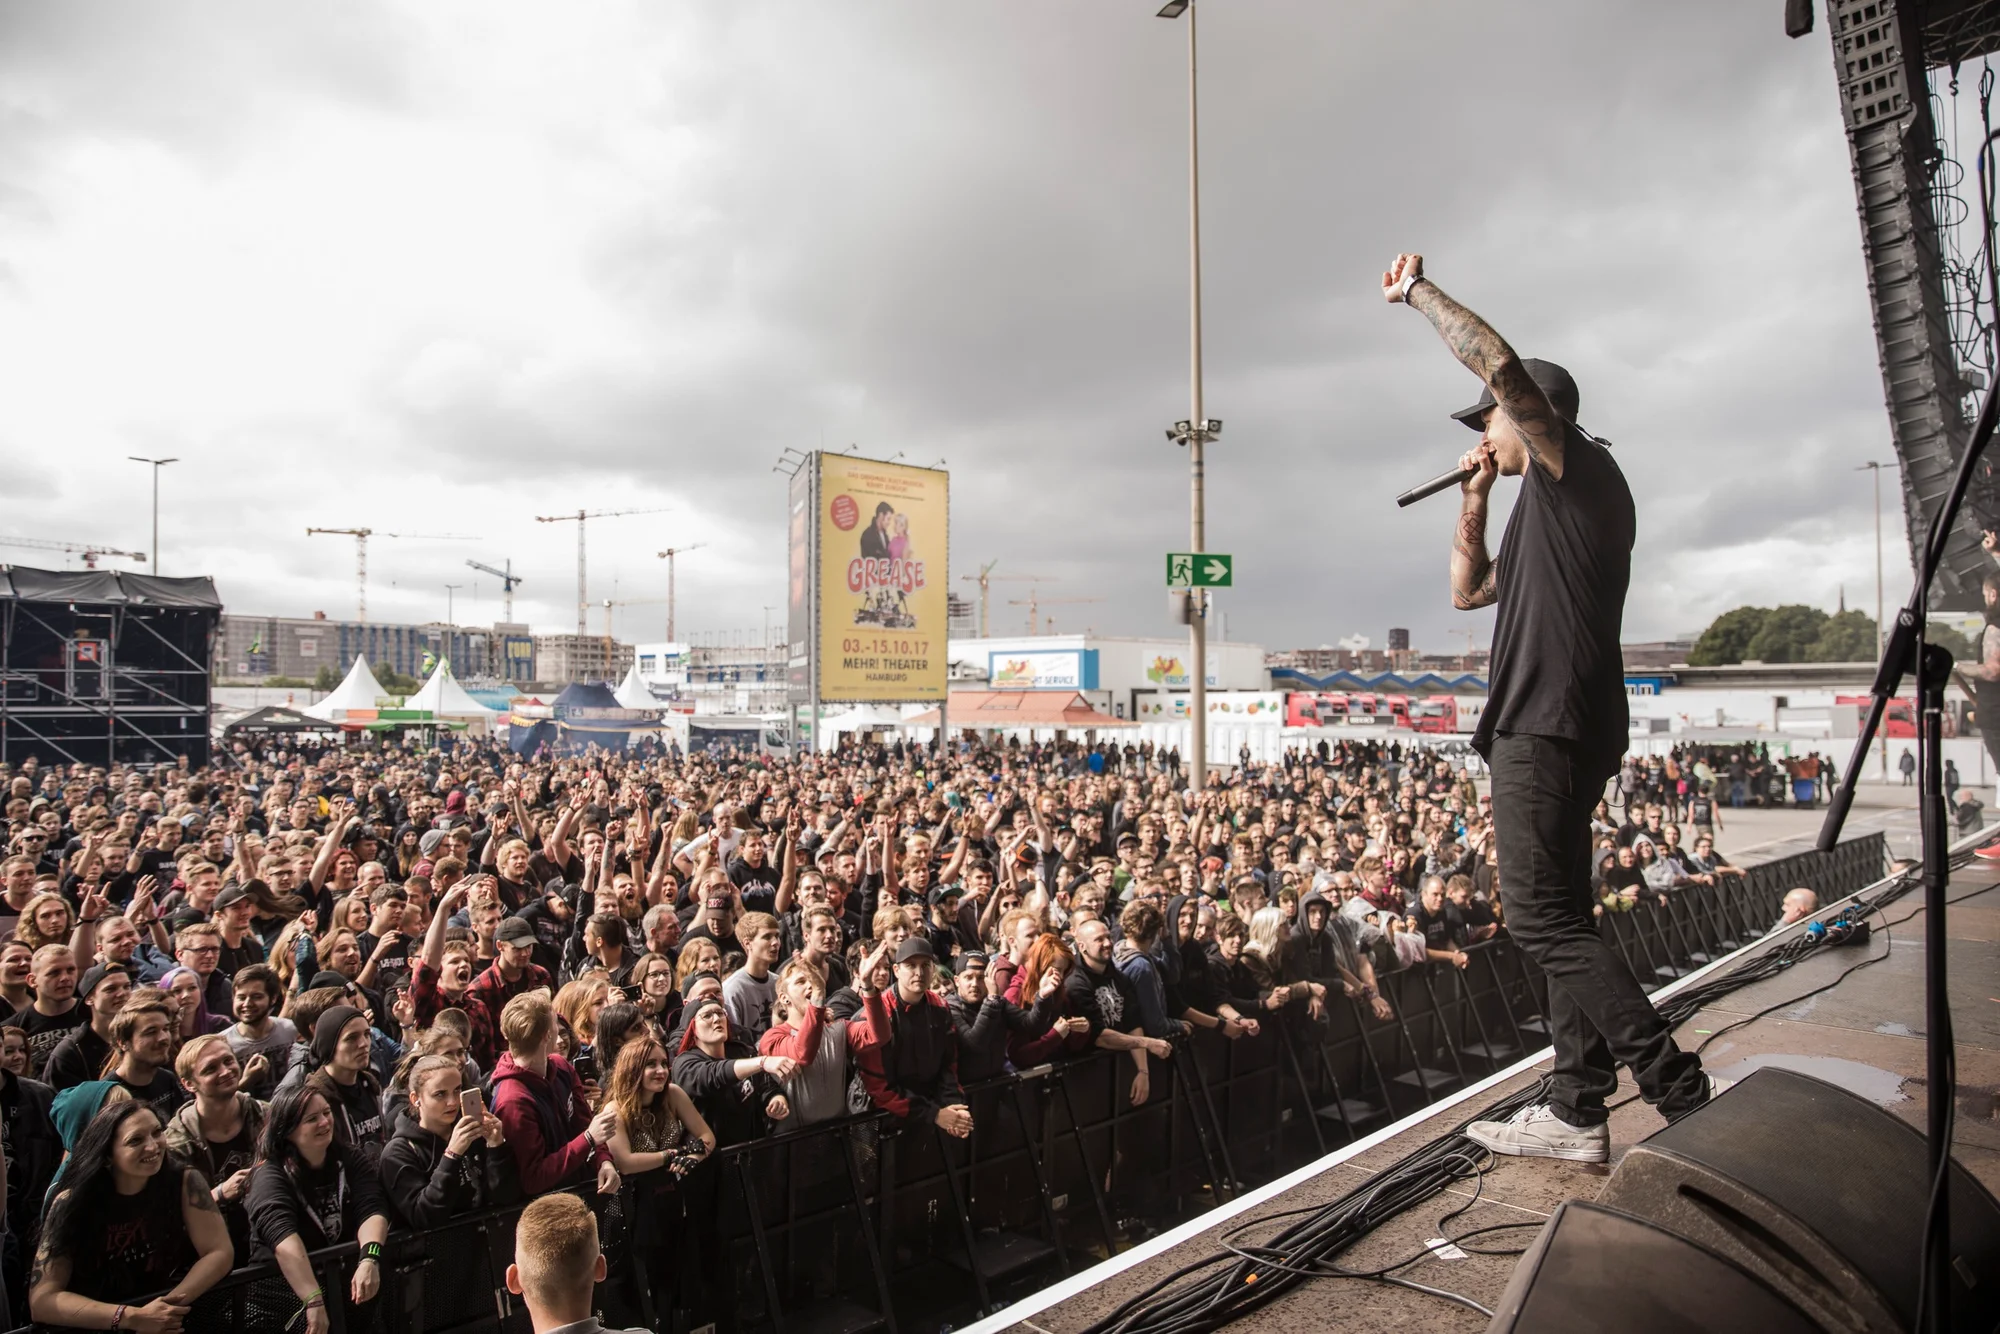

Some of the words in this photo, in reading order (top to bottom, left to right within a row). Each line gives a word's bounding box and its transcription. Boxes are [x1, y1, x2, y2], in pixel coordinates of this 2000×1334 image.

[847, 558, 925, 593] GREASE
[843, 638, 929, 656] 03.-15.10.17
[843, 657, 880, 670] MEHR!
[883, 658, 929, 671] THEATER
[865, 673, 908, 682] HAMBURG
[1045, 675, 1074, 685] SERVICE
